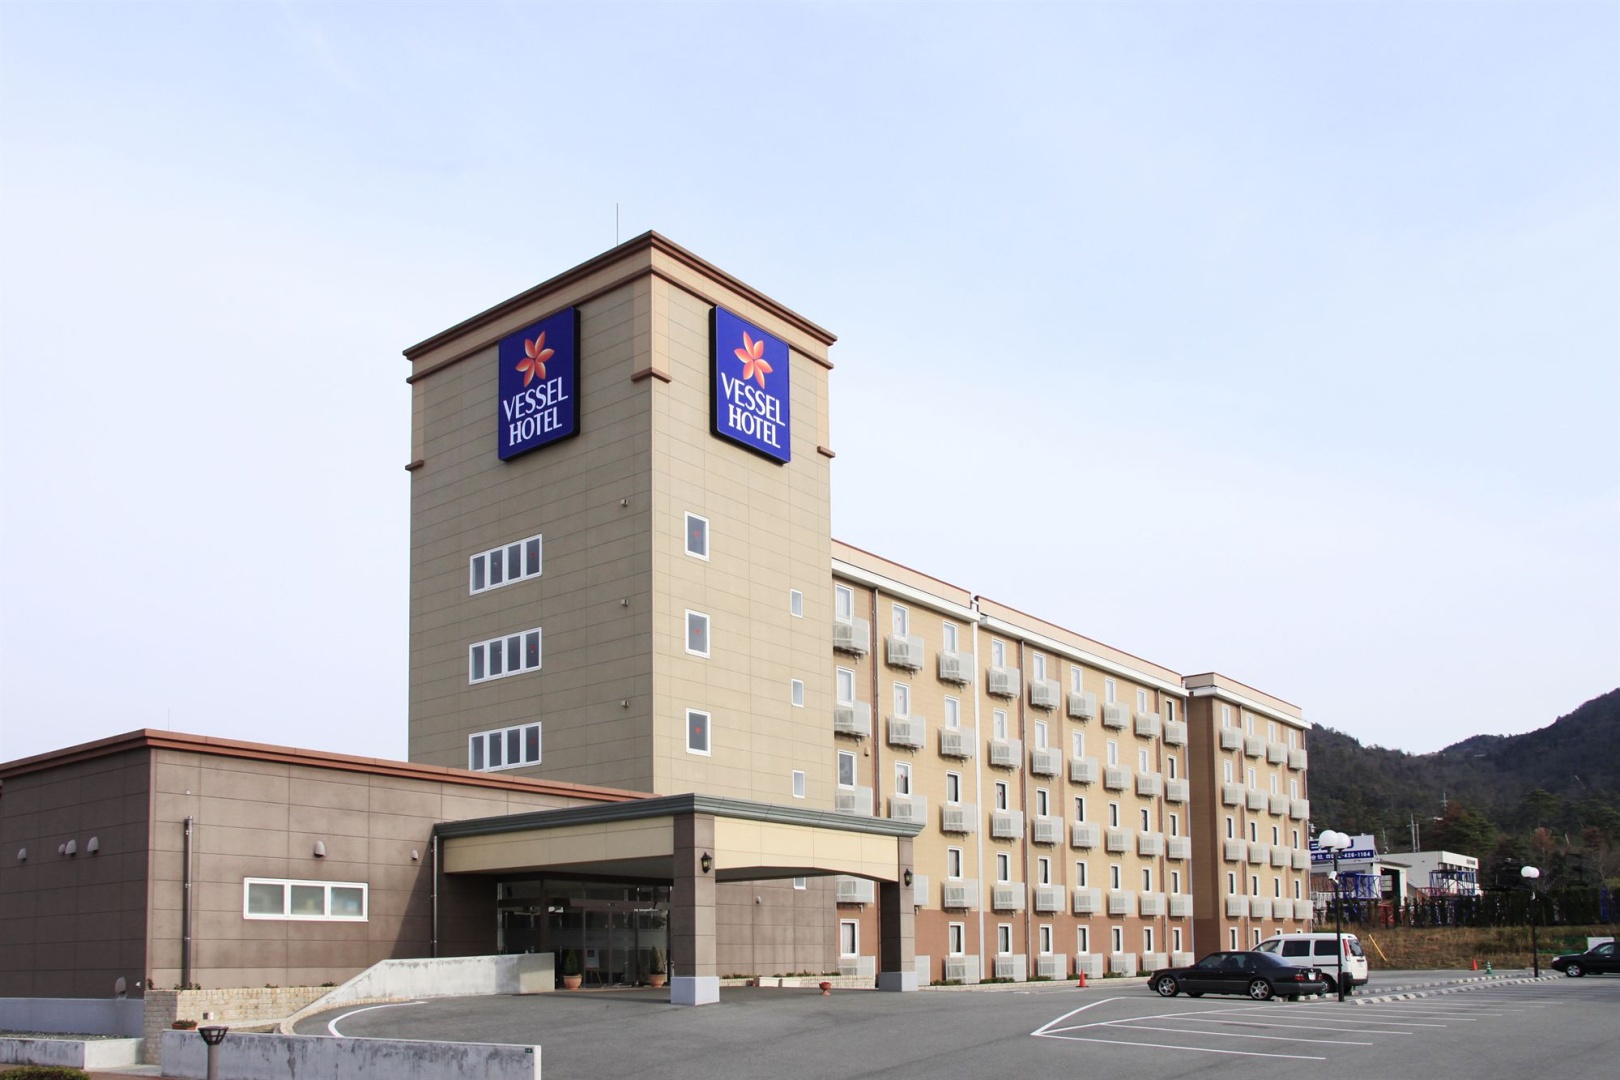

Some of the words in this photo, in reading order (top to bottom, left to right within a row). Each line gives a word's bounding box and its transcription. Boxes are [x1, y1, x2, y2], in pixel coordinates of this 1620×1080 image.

[503, 376, 569, 422] VESSEL
[721, 371, 786, 427] VESSEL
[509, 406, 563, 447] HOTEL
[728, 403, 781, 449] HOTEL
